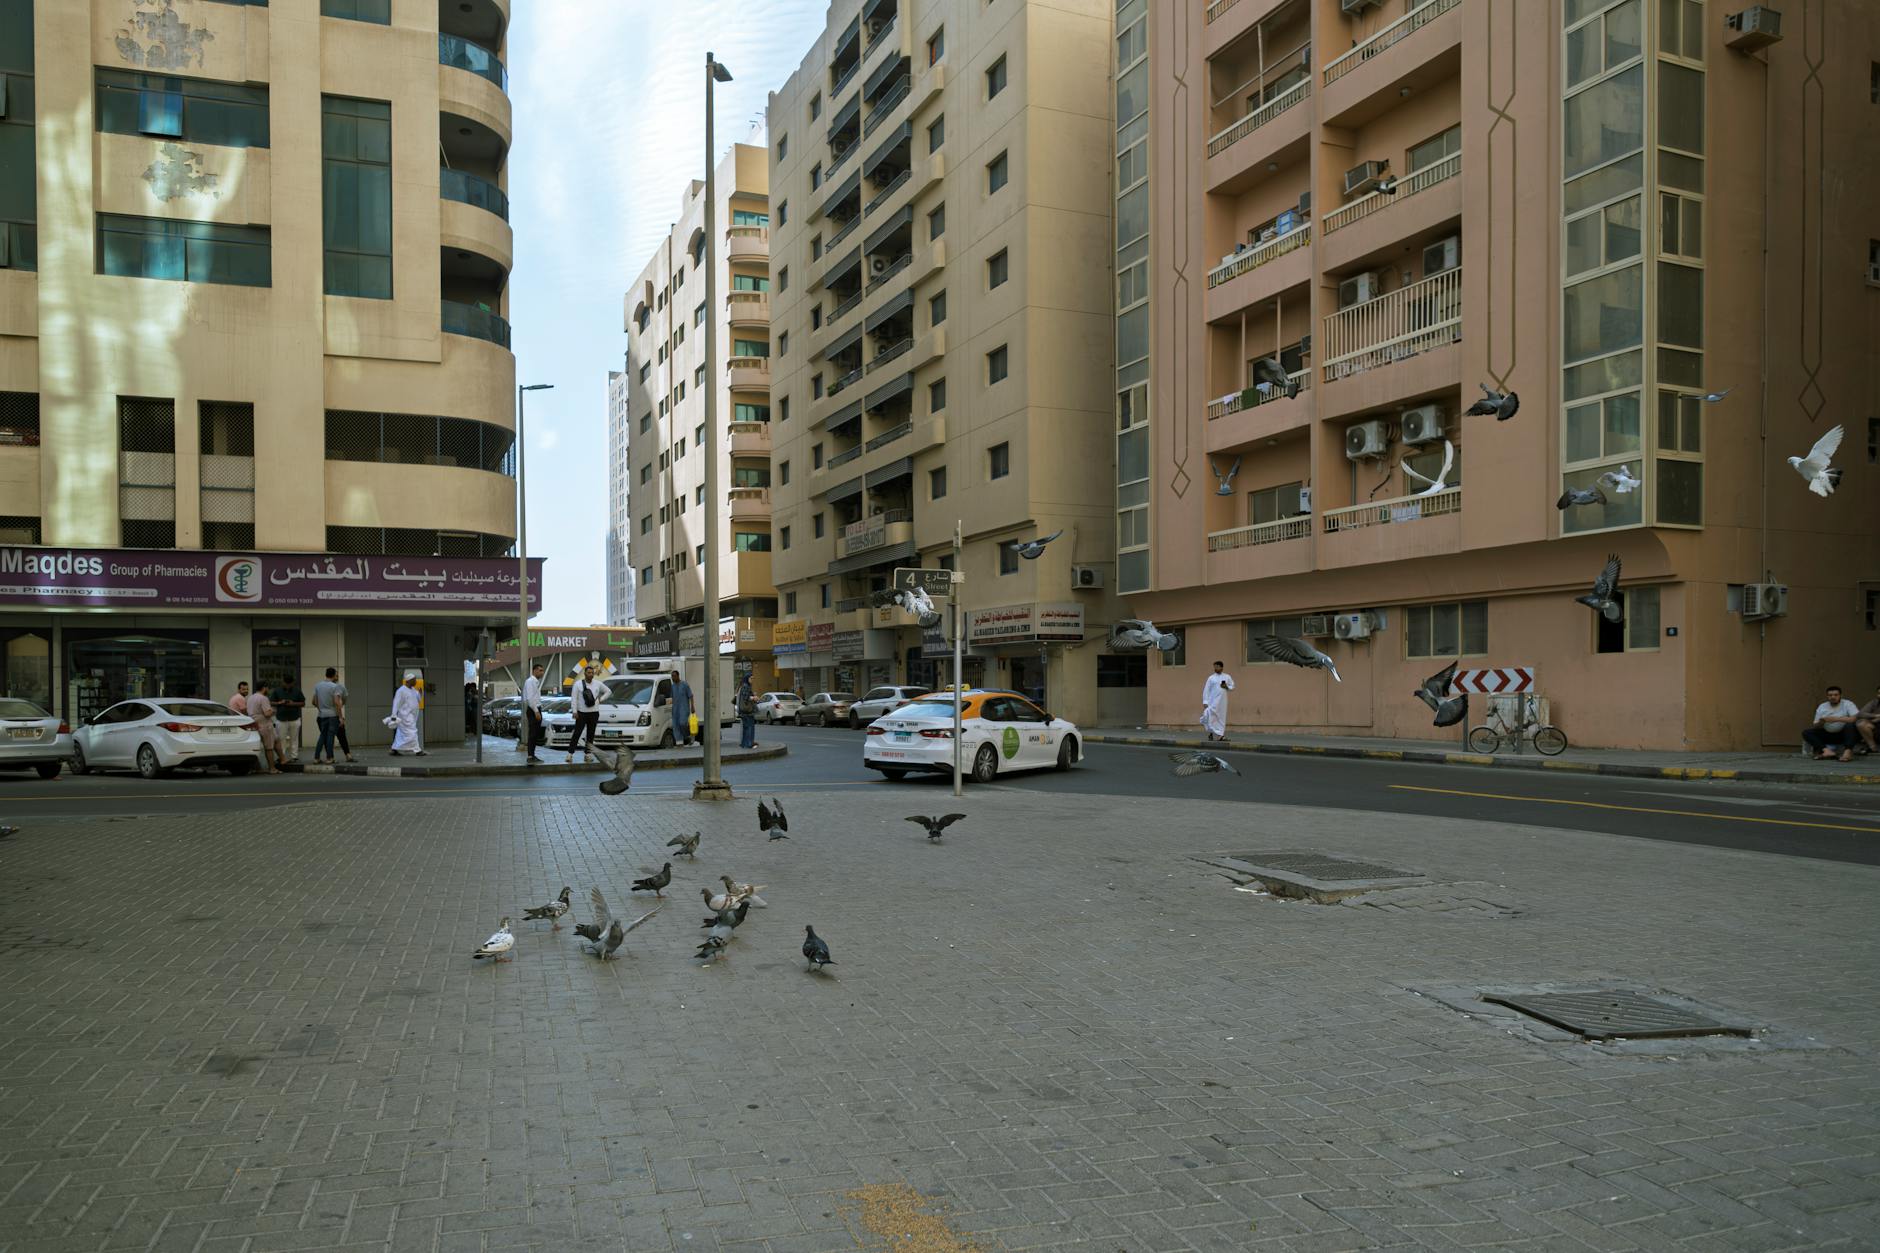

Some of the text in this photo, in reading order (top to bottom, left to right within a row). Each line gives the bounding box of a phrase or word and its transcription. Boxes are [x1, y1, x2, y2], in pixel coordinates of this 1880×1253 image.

[1, 549, 208, 580] Maqdes Group of Pharmacies
[270, 557, 537, 588] مجوعة صيدليات بيت المقدس
[906, 572, 916, 587] 4
[23, 587, 93, 595] Pharmacy
[547, 636, 588, 648] MARKET
